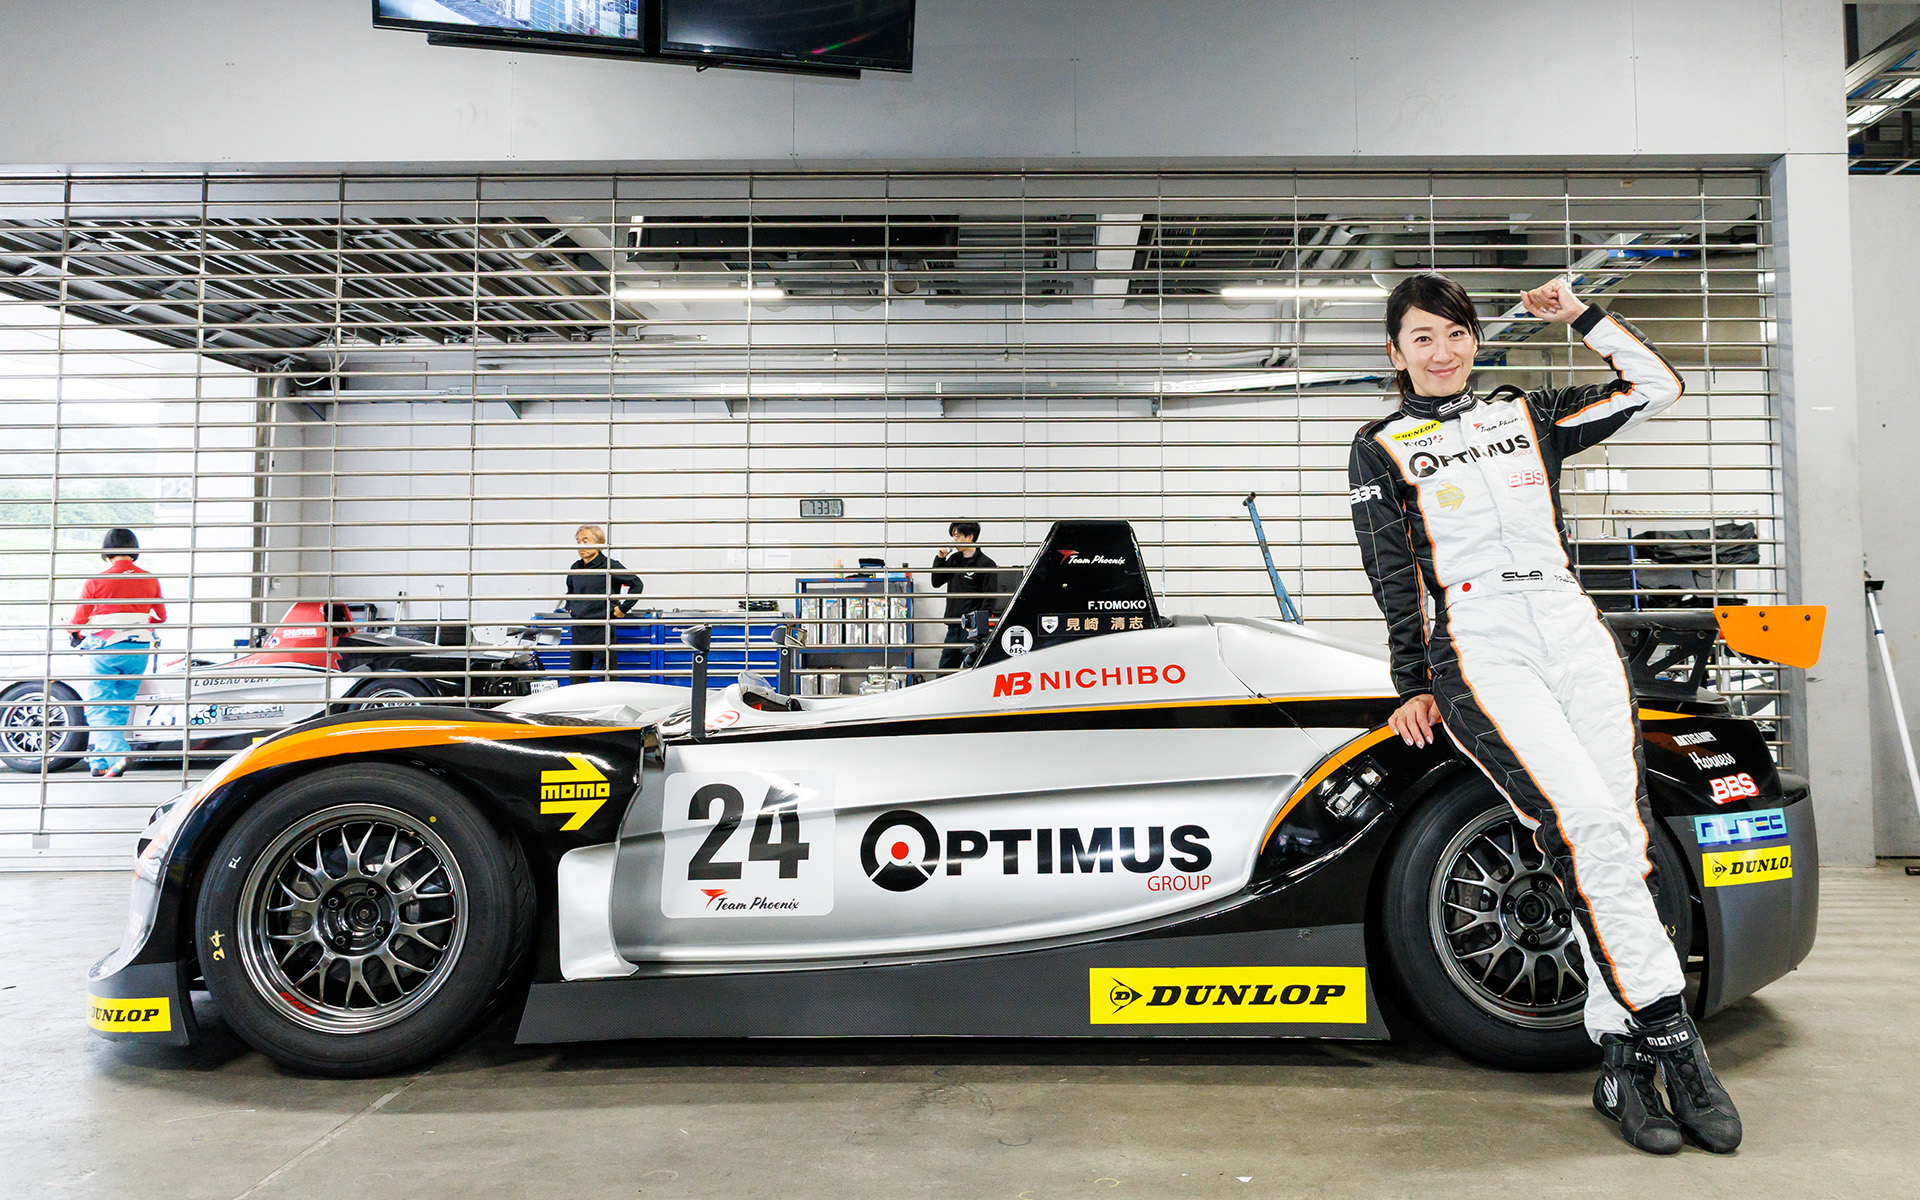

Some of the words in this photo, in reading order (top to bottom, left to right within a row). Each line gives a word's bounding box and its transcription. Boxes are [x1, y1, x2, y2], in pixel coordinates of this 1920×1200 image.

[1402, 423, 1437, 438] DUNLOP
[1508, 469, 1545, 488] BBS
[1068, 555, 1090, 564] Team
[1091, 555, 1125, 565] Phoenix
[1088, 600, 1147, 610] F.TOMOKO
[1040, 664, 1186, 691] NICHIBO
[1709, 772, 1759, 803] BBS
[687, 783, 810, 881] 24
[860, 810, 1212, 892] OPTIMUS
[1729, 856, 1792, 875] DUNLO
[1147, 875, 1212, 892] GROUP
[714, 898, 747, 911] Team
[750, 896, 800, 911] Phoenix
[209, 930, 225, 961] 24
[1145, 984, 1346, 1006] DUNLOP
[91, 1005, 159, 1022] DUNLOP
